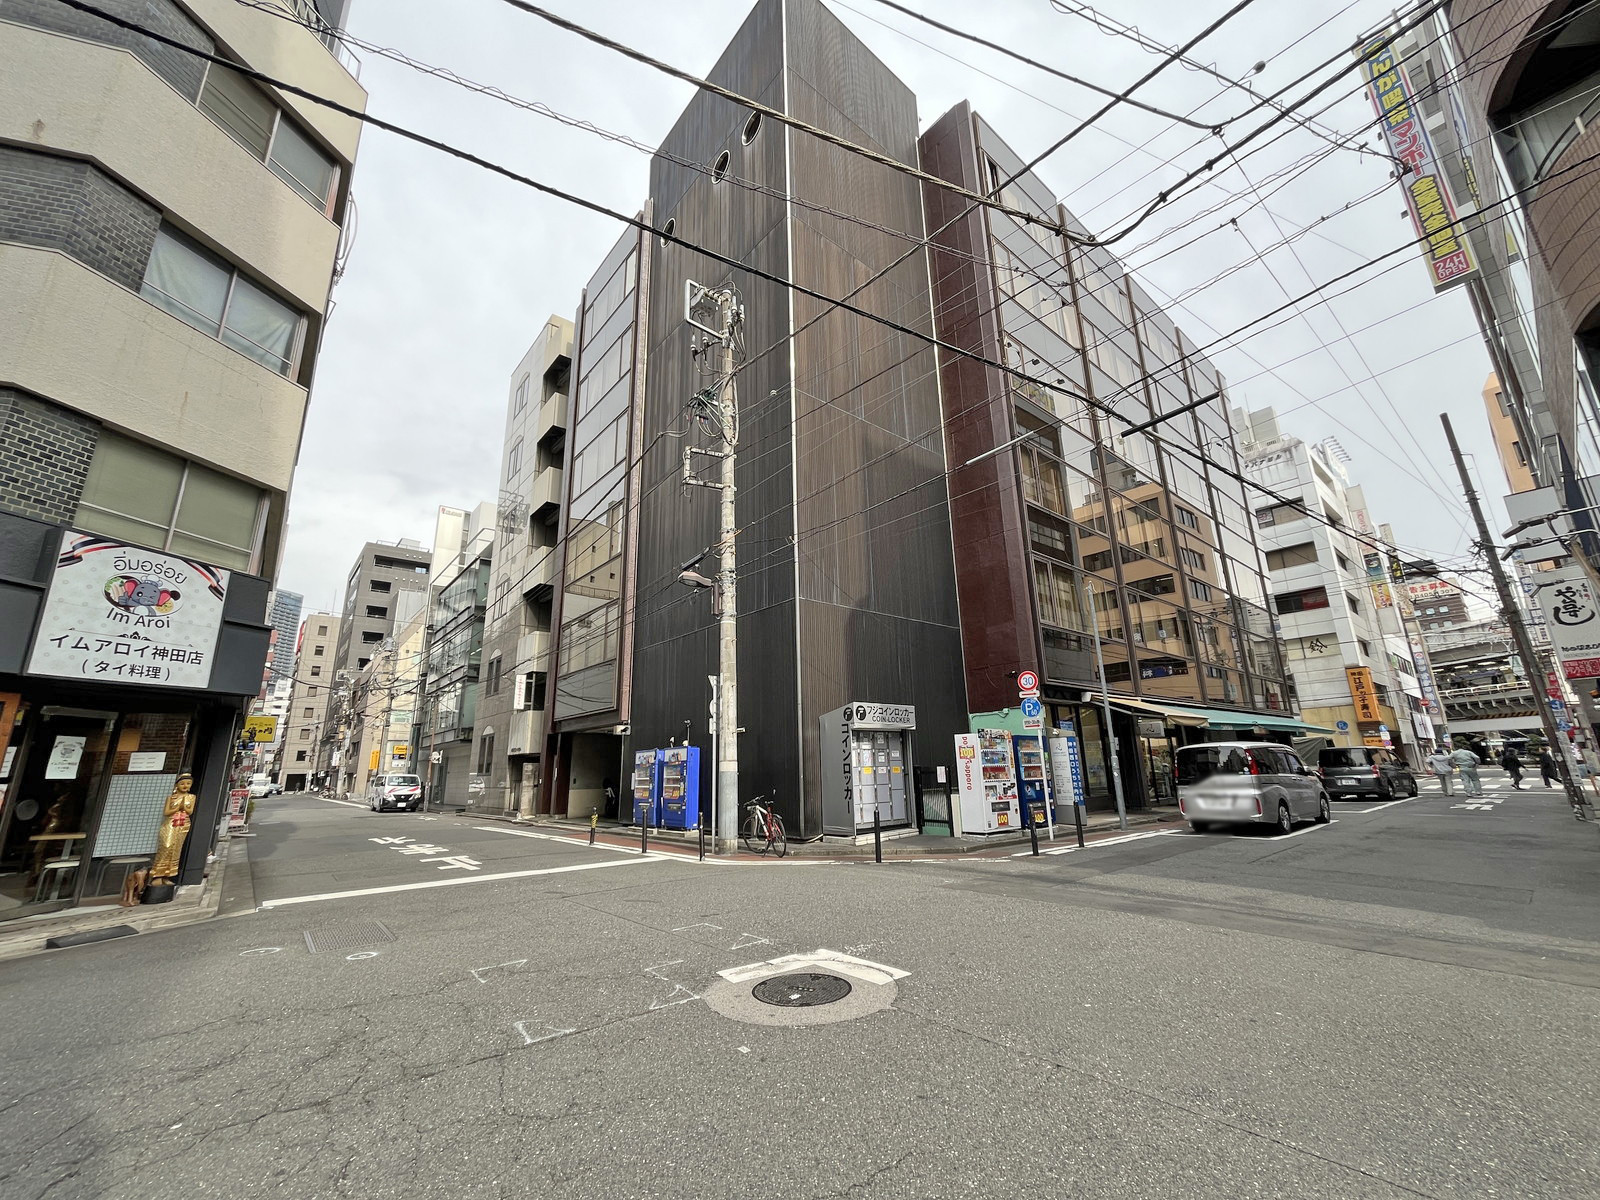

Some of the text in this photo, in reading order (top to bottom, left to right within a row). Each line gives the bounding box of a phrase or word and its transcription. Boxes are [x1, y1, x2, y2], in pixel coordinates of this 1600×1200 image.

[1438, 253, 1464, 272] 24H
[1438, 262, 1467, 278] OPEN
[113, 551, 188, 584] อิ่มอร่อย
[106, 607, 171, 629] Im Aroi
[50, 634, 204, 665] イムアロイ神田店
[1022, 676, 1034, 686] 30
[866, 705, 914, 717] フジコインロッカー
[1025, 703, 1034, 716] P
[841, 723, 852, 814] コインロッカー
[998, 815, 1008, 824] 100
